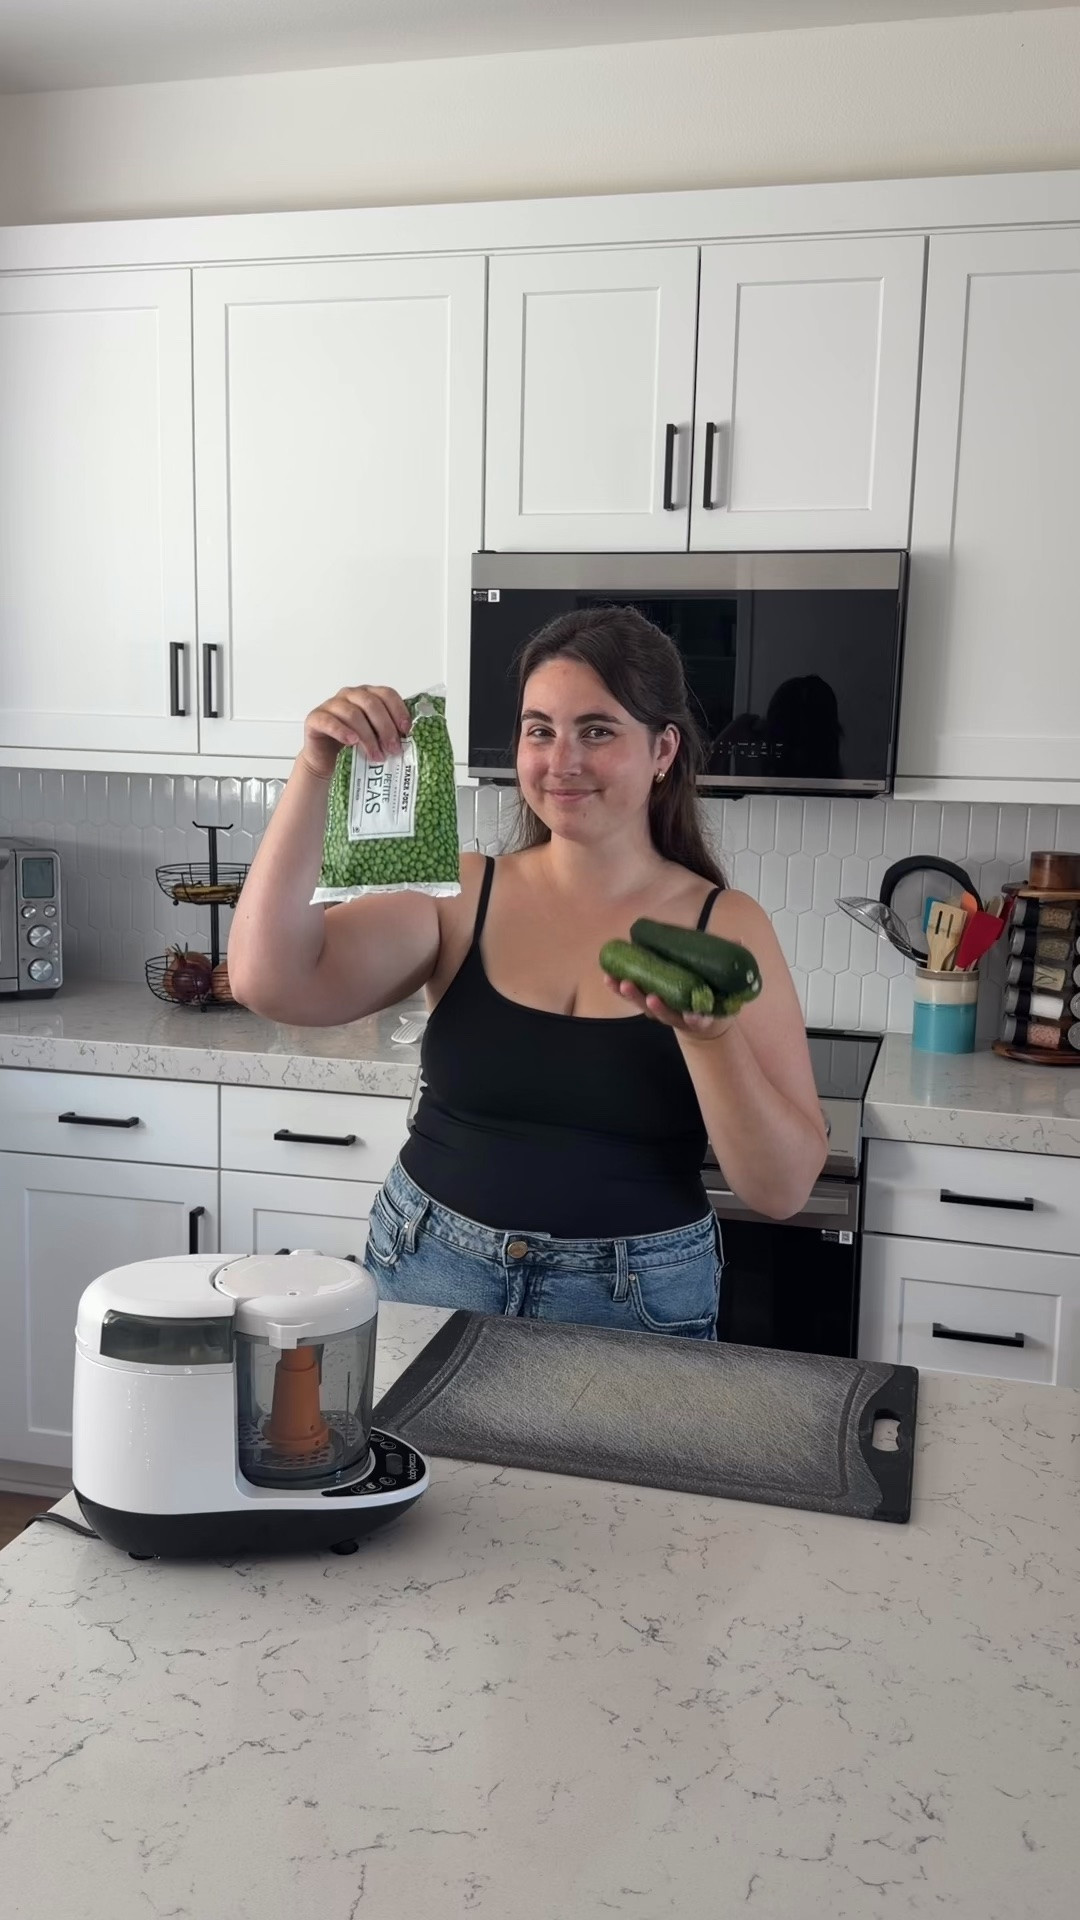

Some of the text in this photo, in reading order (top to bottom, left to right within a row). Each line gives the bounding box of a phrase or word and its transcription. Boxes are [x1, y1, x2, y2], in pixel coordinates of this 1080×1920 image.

[365, 764, 384, 814] PEAS
[382, 774, 392, 804] PETITE
[403, 765, 412, 791] TRADER
